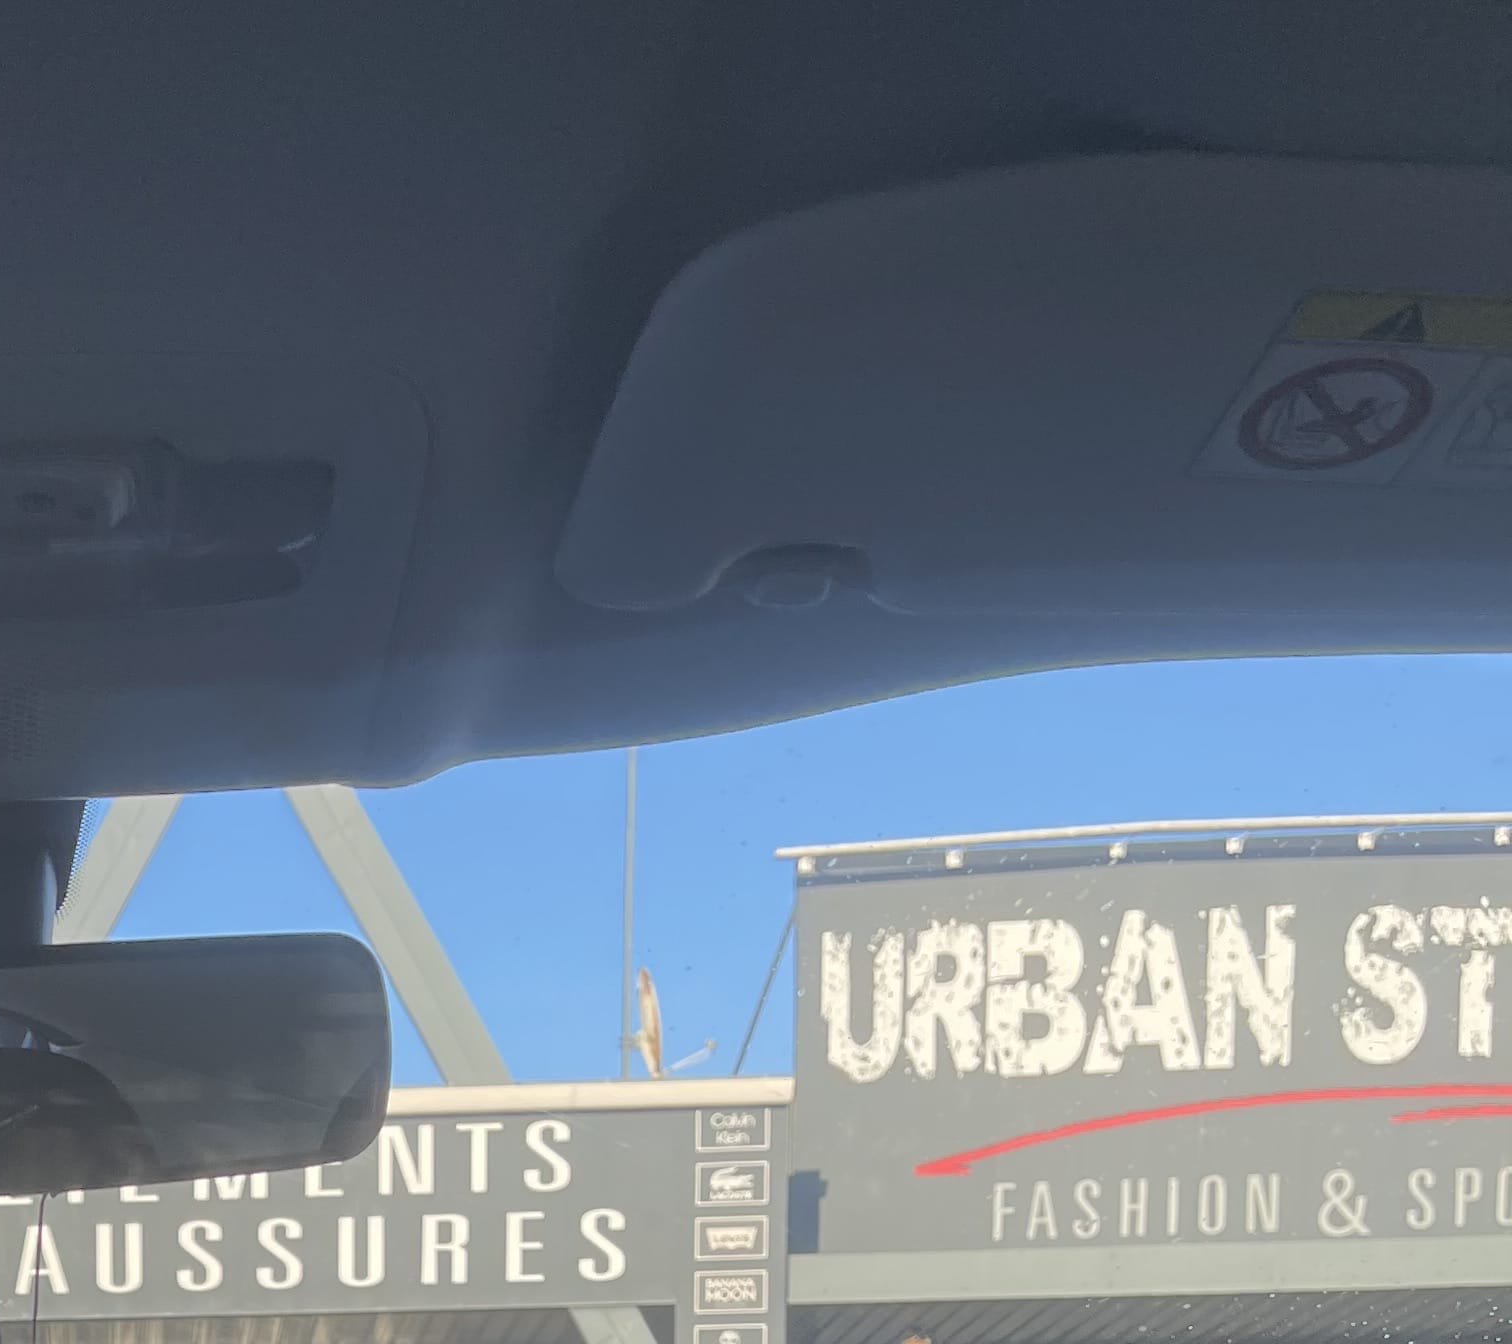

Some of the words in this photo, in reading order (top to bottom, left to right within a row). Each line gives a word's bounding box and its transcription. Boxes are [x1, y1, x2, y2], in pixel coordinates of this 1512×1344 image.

[819, 904, 1296, 1083] URBAN
[990, 1172, 1281, 1242] FASHION
[1316, 1167, 1372, 1238] &
